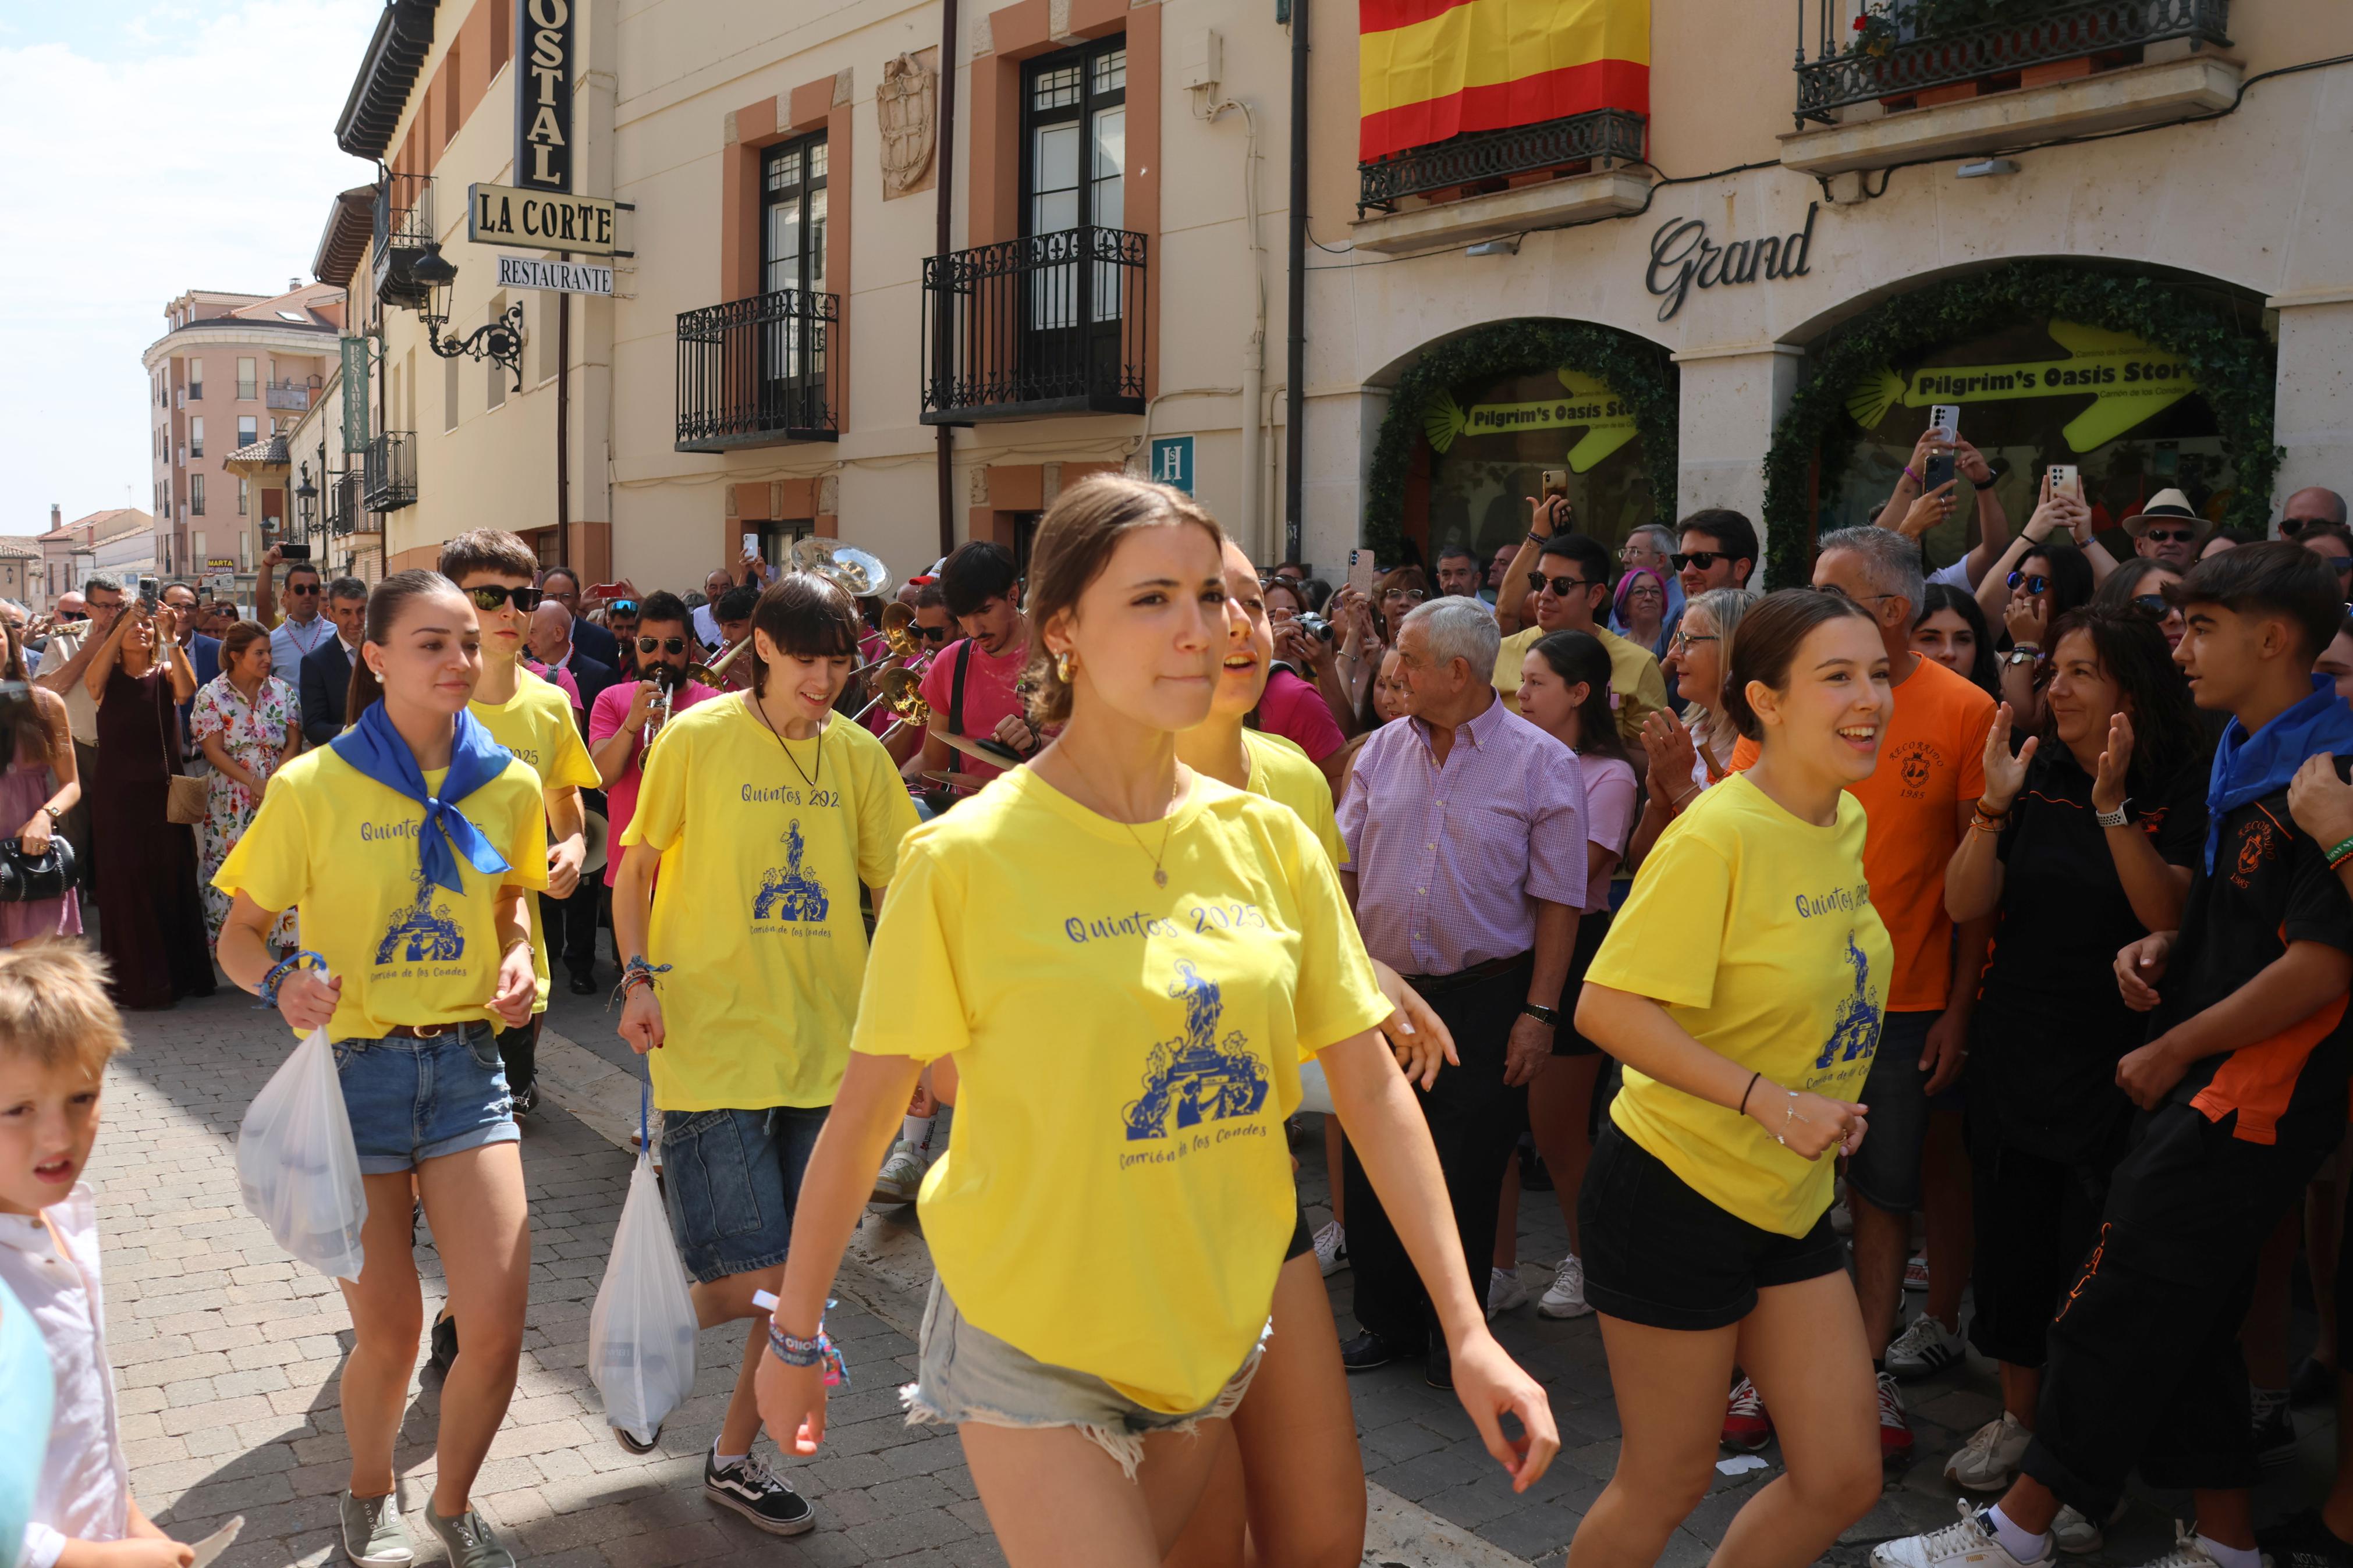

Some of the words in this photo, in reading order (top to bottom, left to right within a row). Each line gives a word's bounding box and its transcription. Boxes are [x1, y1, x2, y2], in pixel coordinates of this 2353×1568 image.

[480, 193, 514, 233] LA
[523, 200, 611, 244] CORTE
[1646, 201, 1818, 322] Grand
[501, 259, 611, 293] RESTAURANTE
[1919, 371, 2036, 396] Pilgrim's
[2044, 365, 2116, 387] Oasis
[2124, 361, 2184, 382] Stor
[350, 345, 362, 449] RESTAURANTE
[1474, 407, 1550, 428] Pilgrim's
[1555, 403, 1600, 421] Oasis
[509, 748, 538, 765] 025
[1889, 741, 1944, 767] RECORRIDO
[741, 783, 801, 806] Quintos
[809, 788, 839, 808] 202
[1900, 788, 1925, 799] 1985
[361, 818, 419, 841] Quinto
[2230, 872, 2251, 889] 1985
[1795, 887, 1854, 918] Quintos
[778, 925, 787, 934] de
[792, 927, 803, 937] los
[1065, 911, 1179, 943] Quintos
[1190, 904, 1266, 935] 2025
[402, 968, 412, 978] de
[417, 967, 428, 978] los
[434, 967, 467, 977] Condes
[1119, 1150, 1181, 1171] Carrión
[1193, 1134, 1210, 1152] los
[1216, 1123, 1267, 1144] Condes
[2291, 1552, 2314, 1564] NOT
